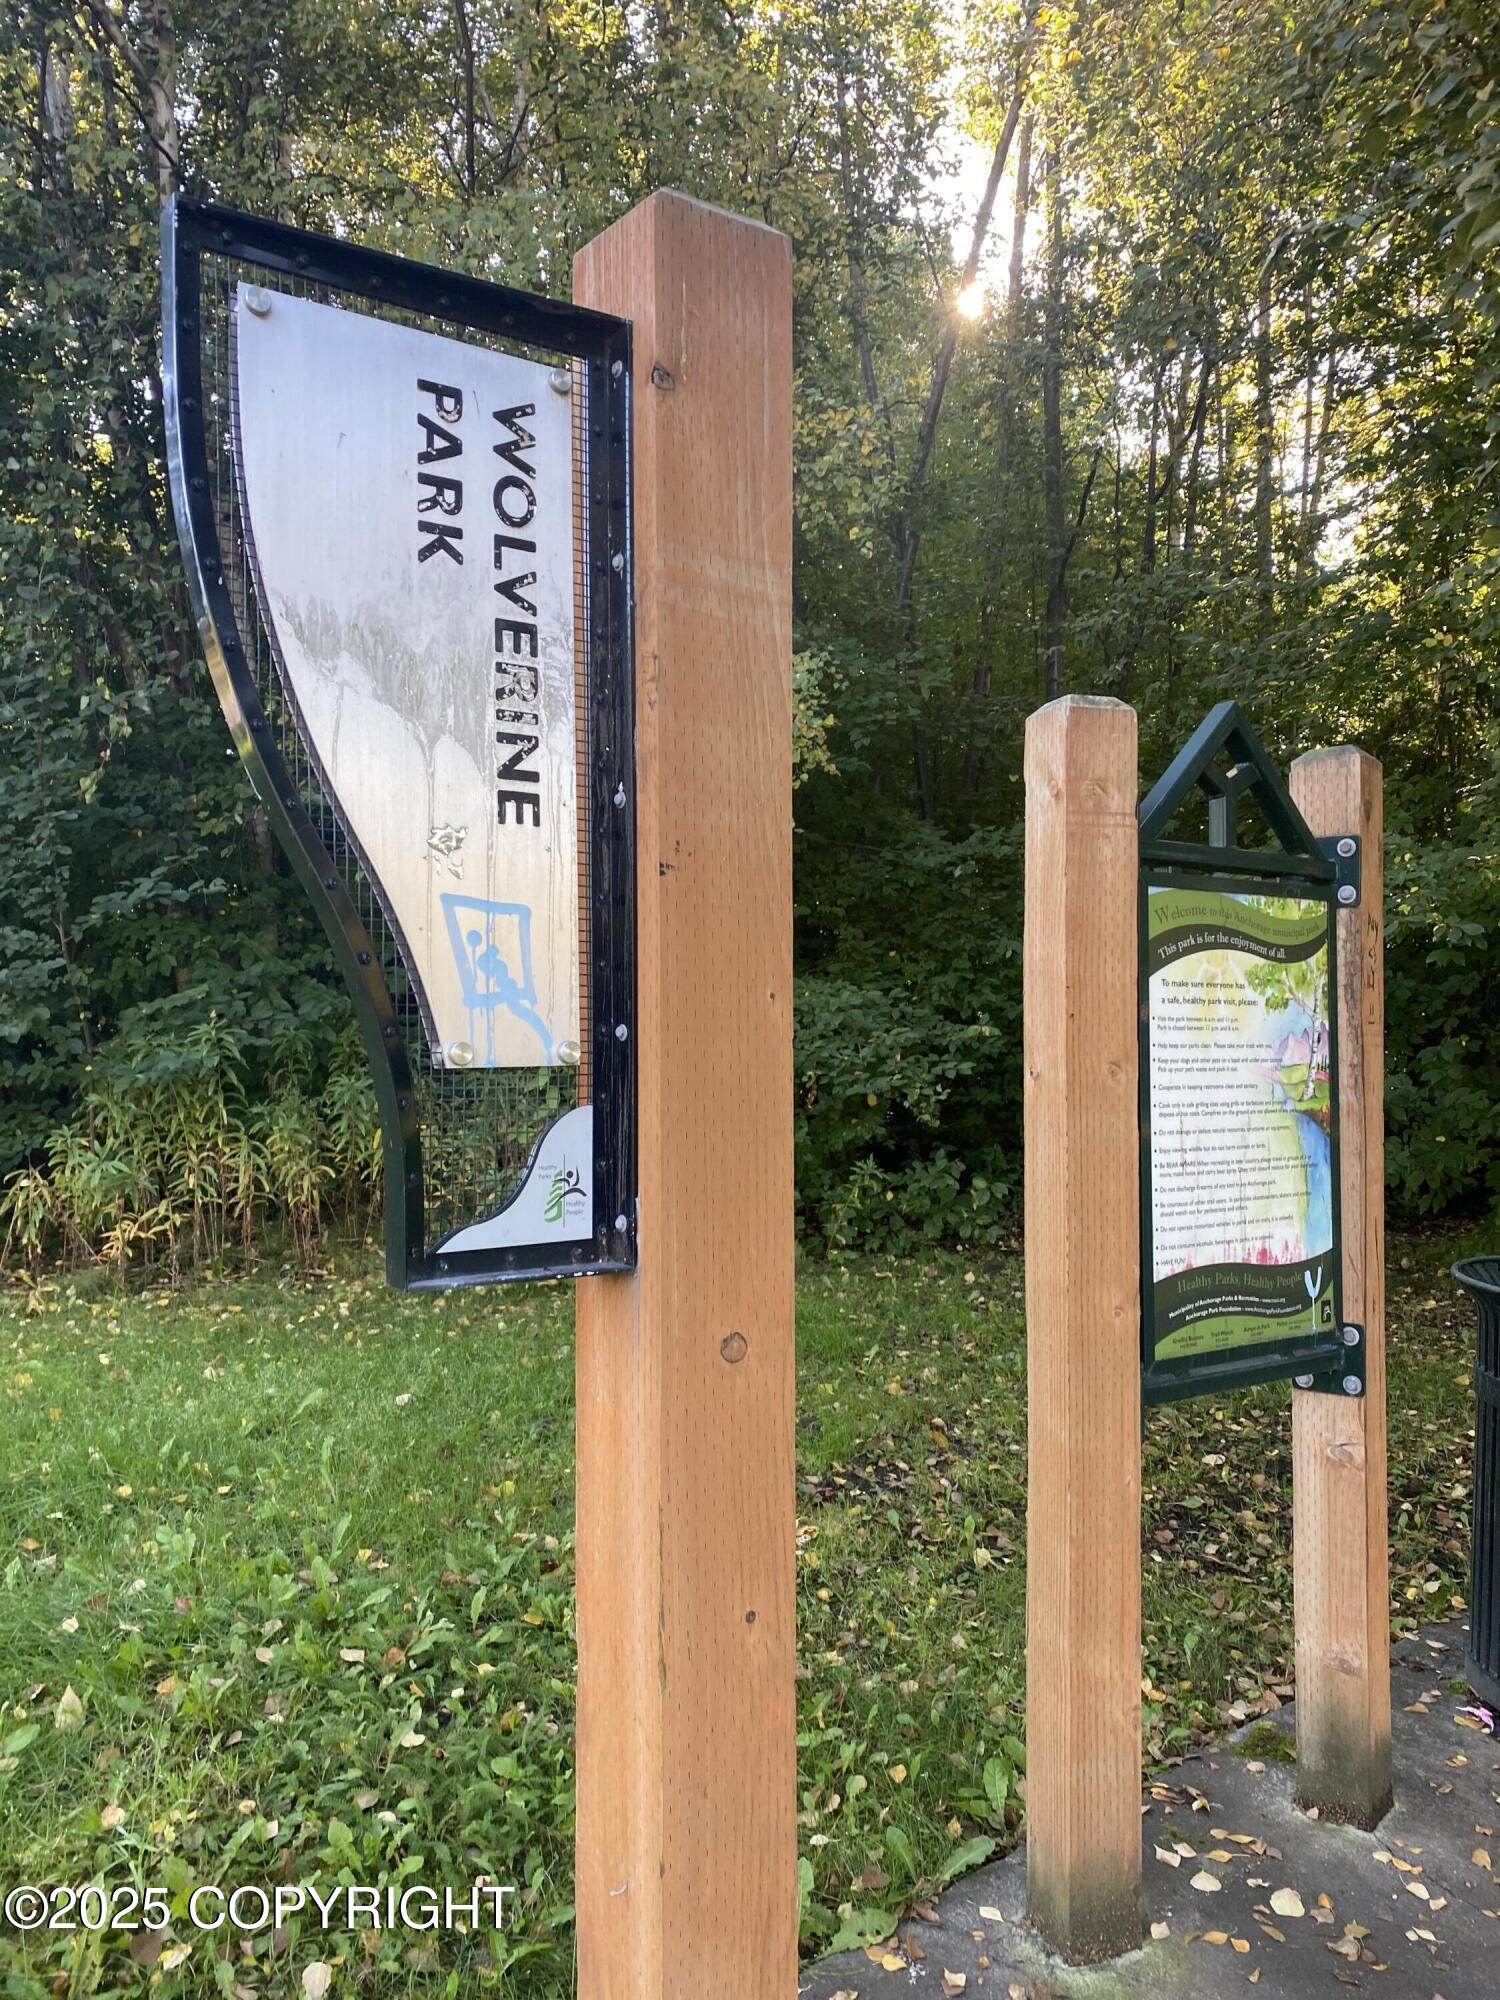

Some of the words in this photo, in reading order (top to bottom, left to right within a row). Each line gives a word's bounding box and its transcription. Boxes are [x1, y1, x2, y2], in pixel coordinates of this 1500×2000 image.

[417, 378, 463, 566] PARK
[493, 403, 540, 827] WOLVERINE
[1154, 905, 1207, 924] Welcome
[1210, 907, 1217, 916] to
[1157, 944, 1177, 960] This
[1178, 934, 1196, 952] park
[1196, 933, 1204, 944] is
[1204, 932, 1216, 943] for
[1216, 932, 1229, 943] the
[1230, 937, 1268, 956] enjoyment
[1268, 947, 1276, 958] of
[1276, 949, 1287, 959] all.
[1161, 979, 1169, 987] To
[1171, 979, 1189, 988] make
[1206, 982, 1234, 990] everyone
[1167, 997, 1182, 1005] safe,
[1182, 997, 1206, 1007] healthy
[1207, 997, 1221, 1006] park
[1238, 998, 1259, 1007] please:
[1178, 1274, 1212, 1293] Healthy
[1215, 1271, 1241, 1287] Parks,
[1243, 1272, 1274, 1291] Healthy
[1275, 1272, 1302, 1289] People
[1200, 1297, 1222, 1306] Anchorage
[1185, 1309, 1208, 1321] Anchorage
[1208, 1307, 1219, 1315] Park
